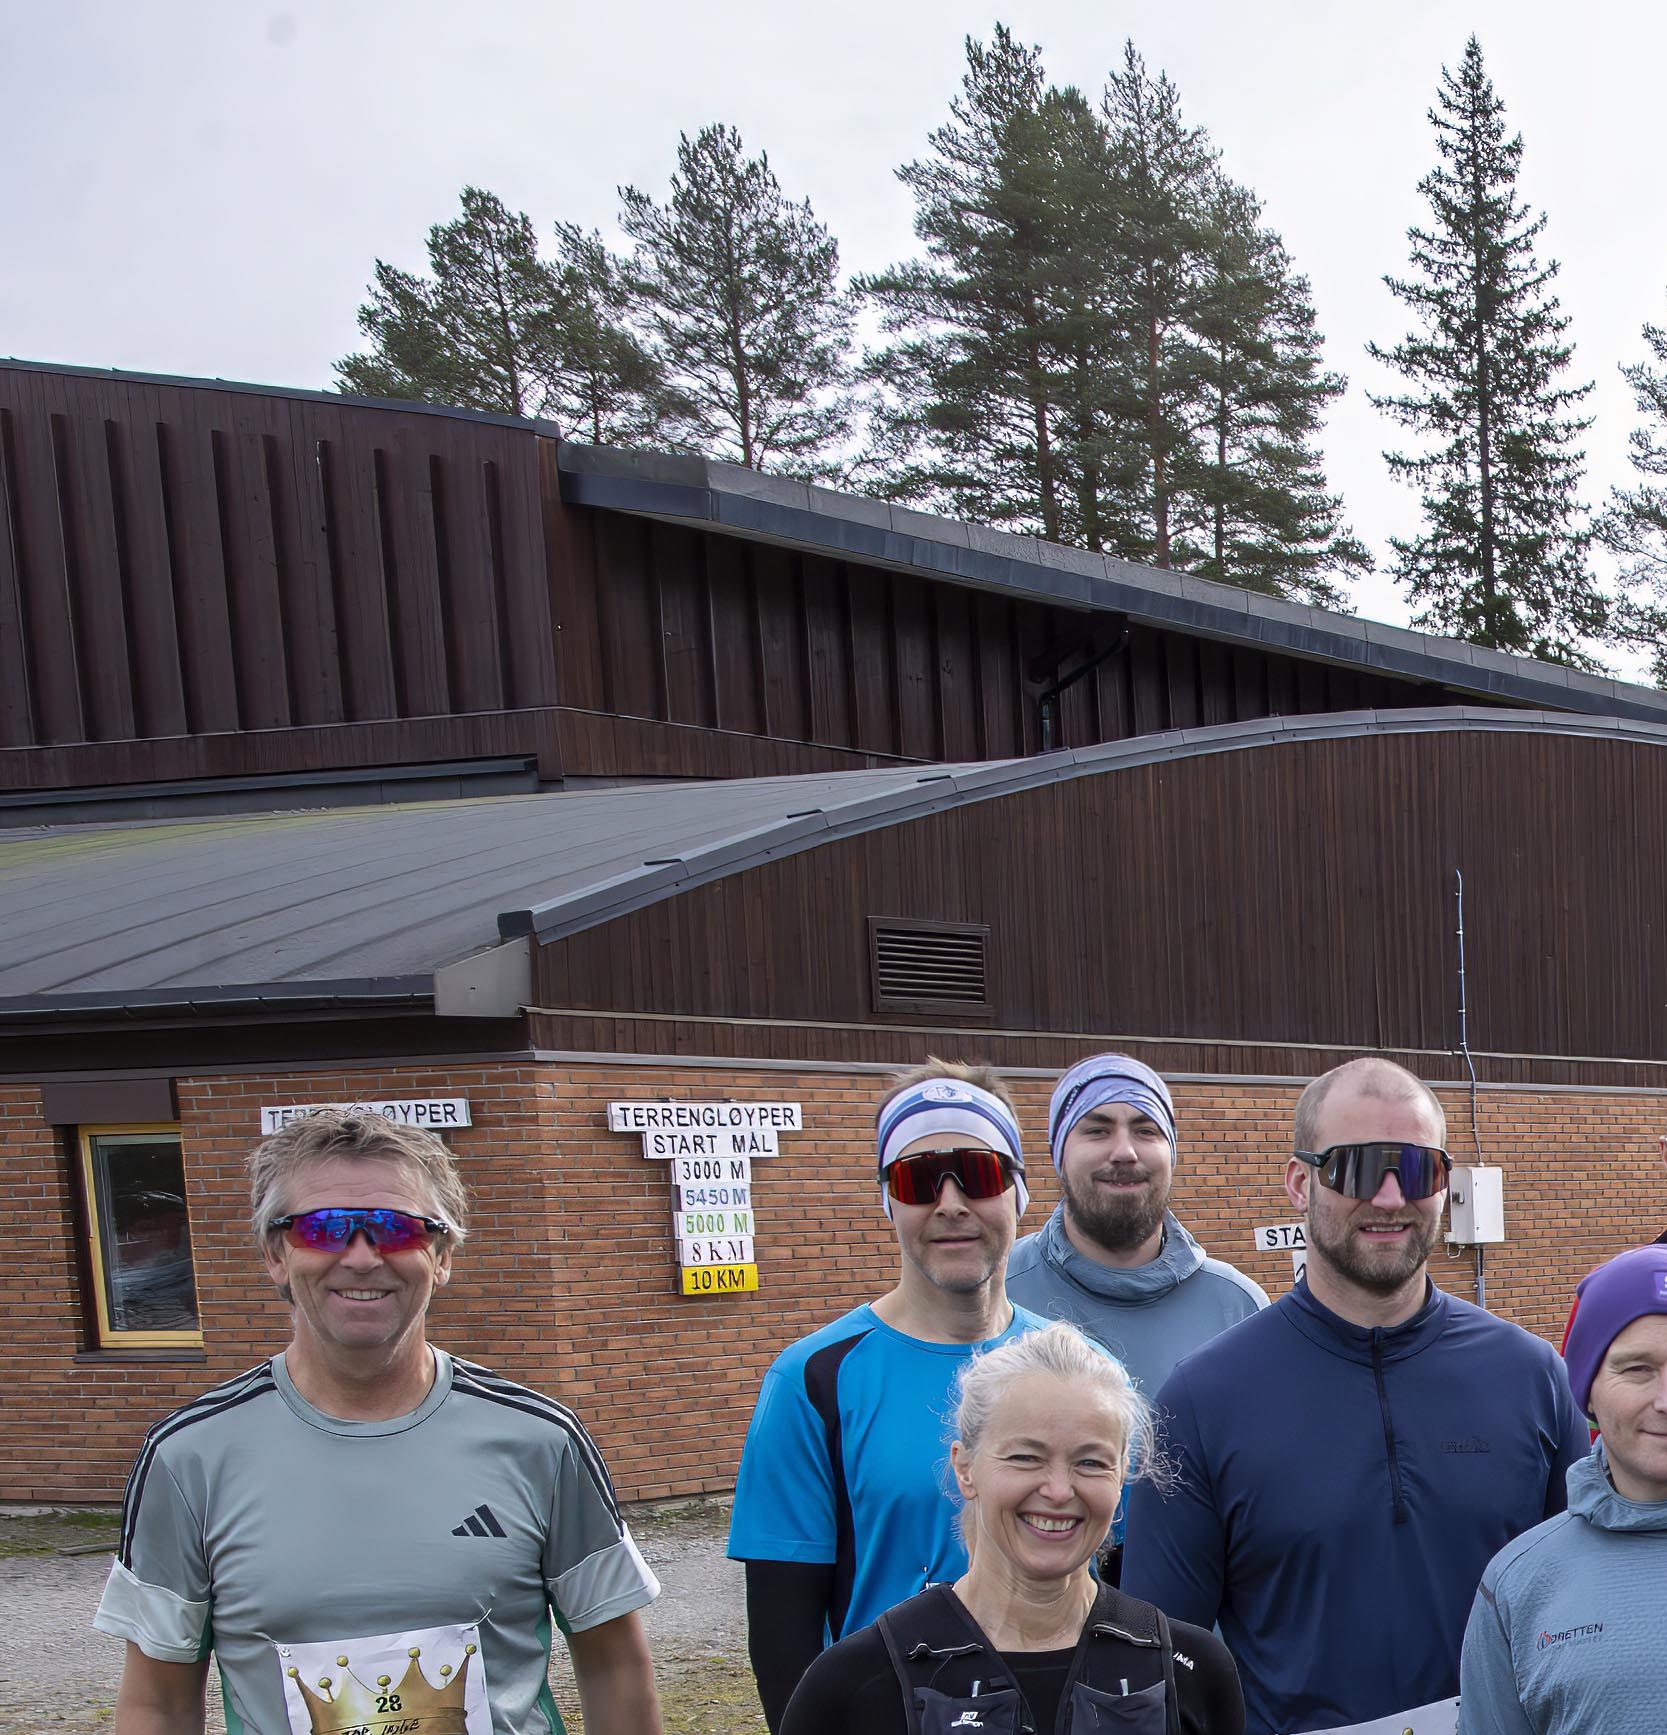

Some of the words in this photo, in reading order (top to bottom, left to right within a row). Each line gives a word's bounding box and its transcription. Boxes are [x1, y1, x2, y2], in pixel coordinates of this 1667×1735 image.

[619, 1107, 796, 1128] TERRENGLØYPER
[653, 1134, 718, 1155] START
[732, 1131, 773, 1153] MÅL
[682, 1160, 721, 1181] 3000
[730, 1160, 745, 1180] M
[685, 1188, 728, 1206] 5450
[732, 1188, 747, 1205] M
[685, 1214, 725, 1234] 5000
[734, 1212, 748, 1233] M
[692, 1242, 702, 1263] 8
[708, 1240, 745, 1262] KM
[691, 1270, 712, 1290] 10
[716, 1269, 746, 1289] KM
[375, 1694, 402, 1714] 28
